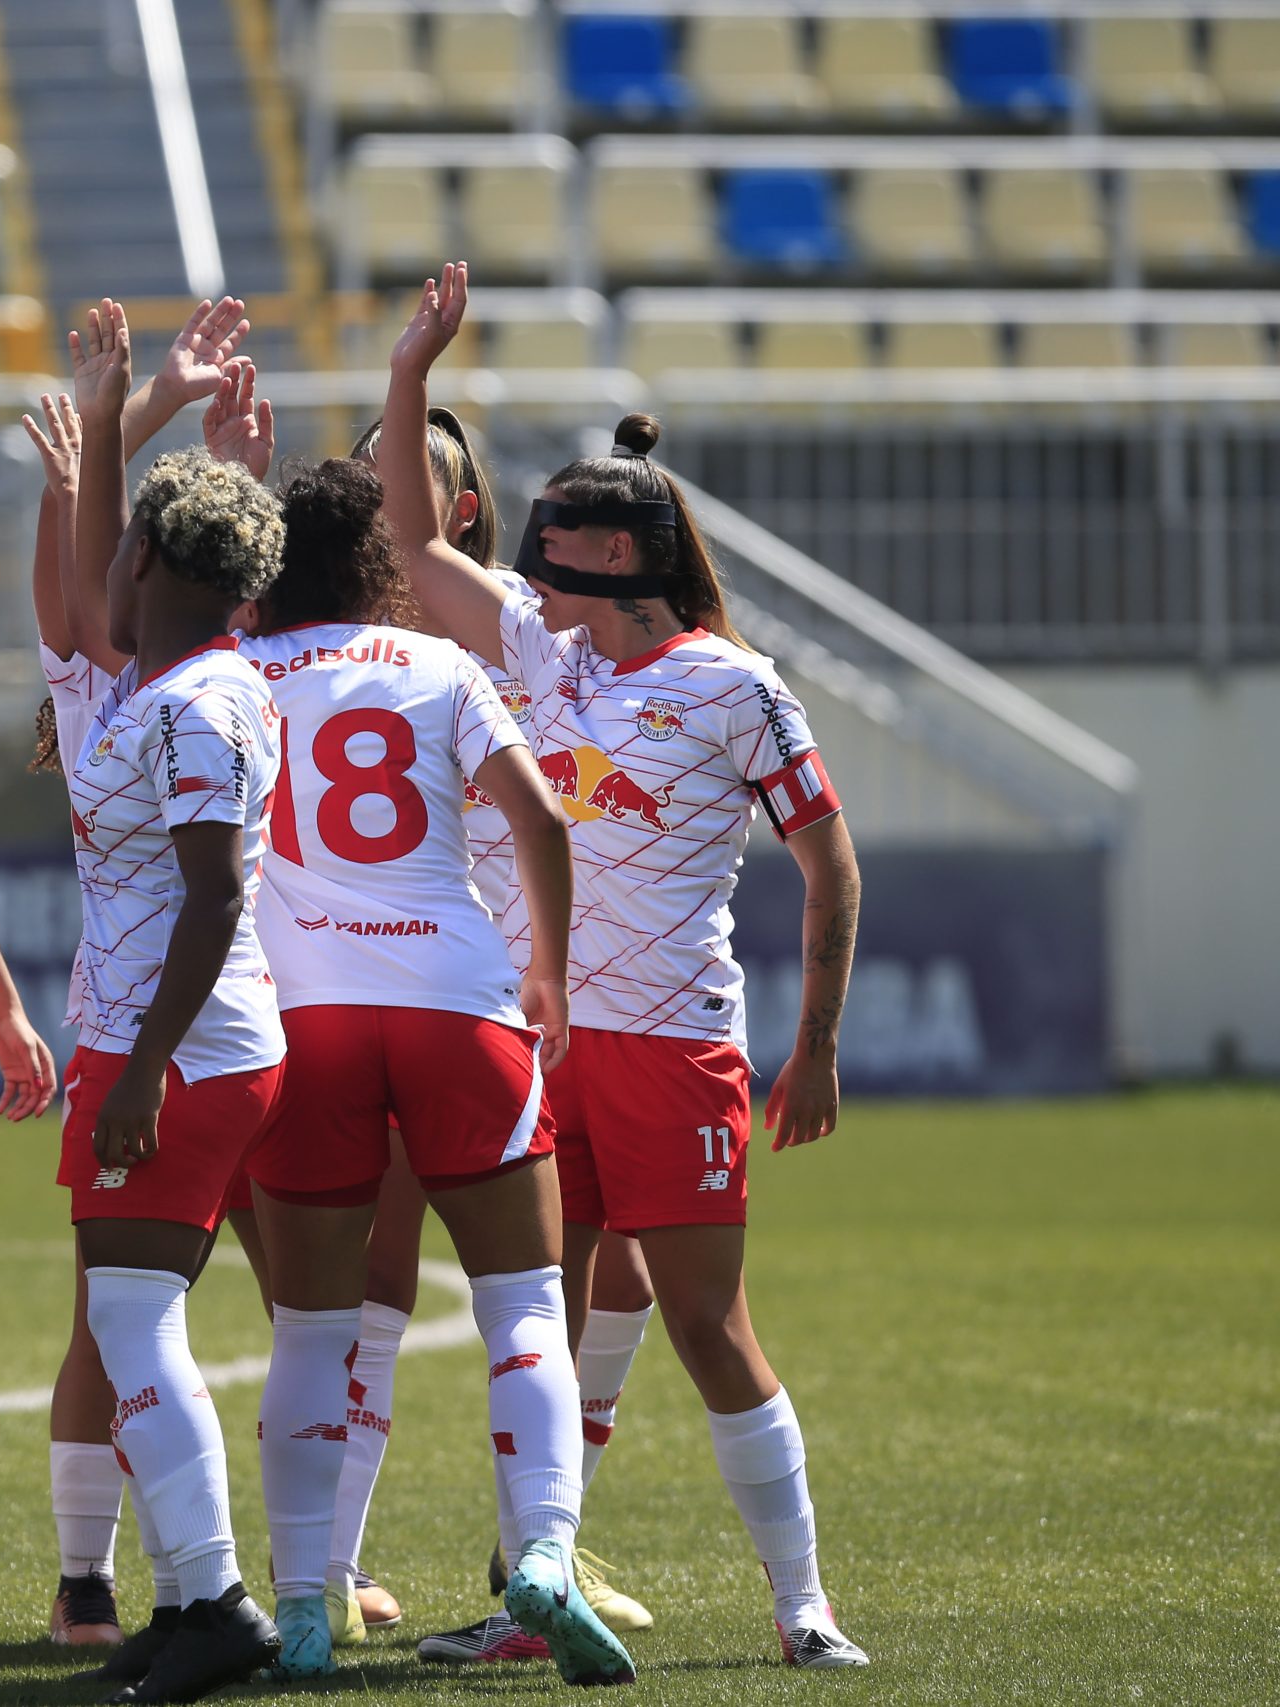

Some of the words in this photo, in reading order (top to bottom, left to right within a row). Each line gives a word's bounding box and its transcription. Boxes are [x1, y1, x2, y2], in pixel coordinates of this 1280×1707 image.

[753, 682, 793, 767] mrJack.be
[269, 707, 428, 868] 18
[334, 918, 439, 938] YANMAR
[697, 1125, 730, 1163] 11
